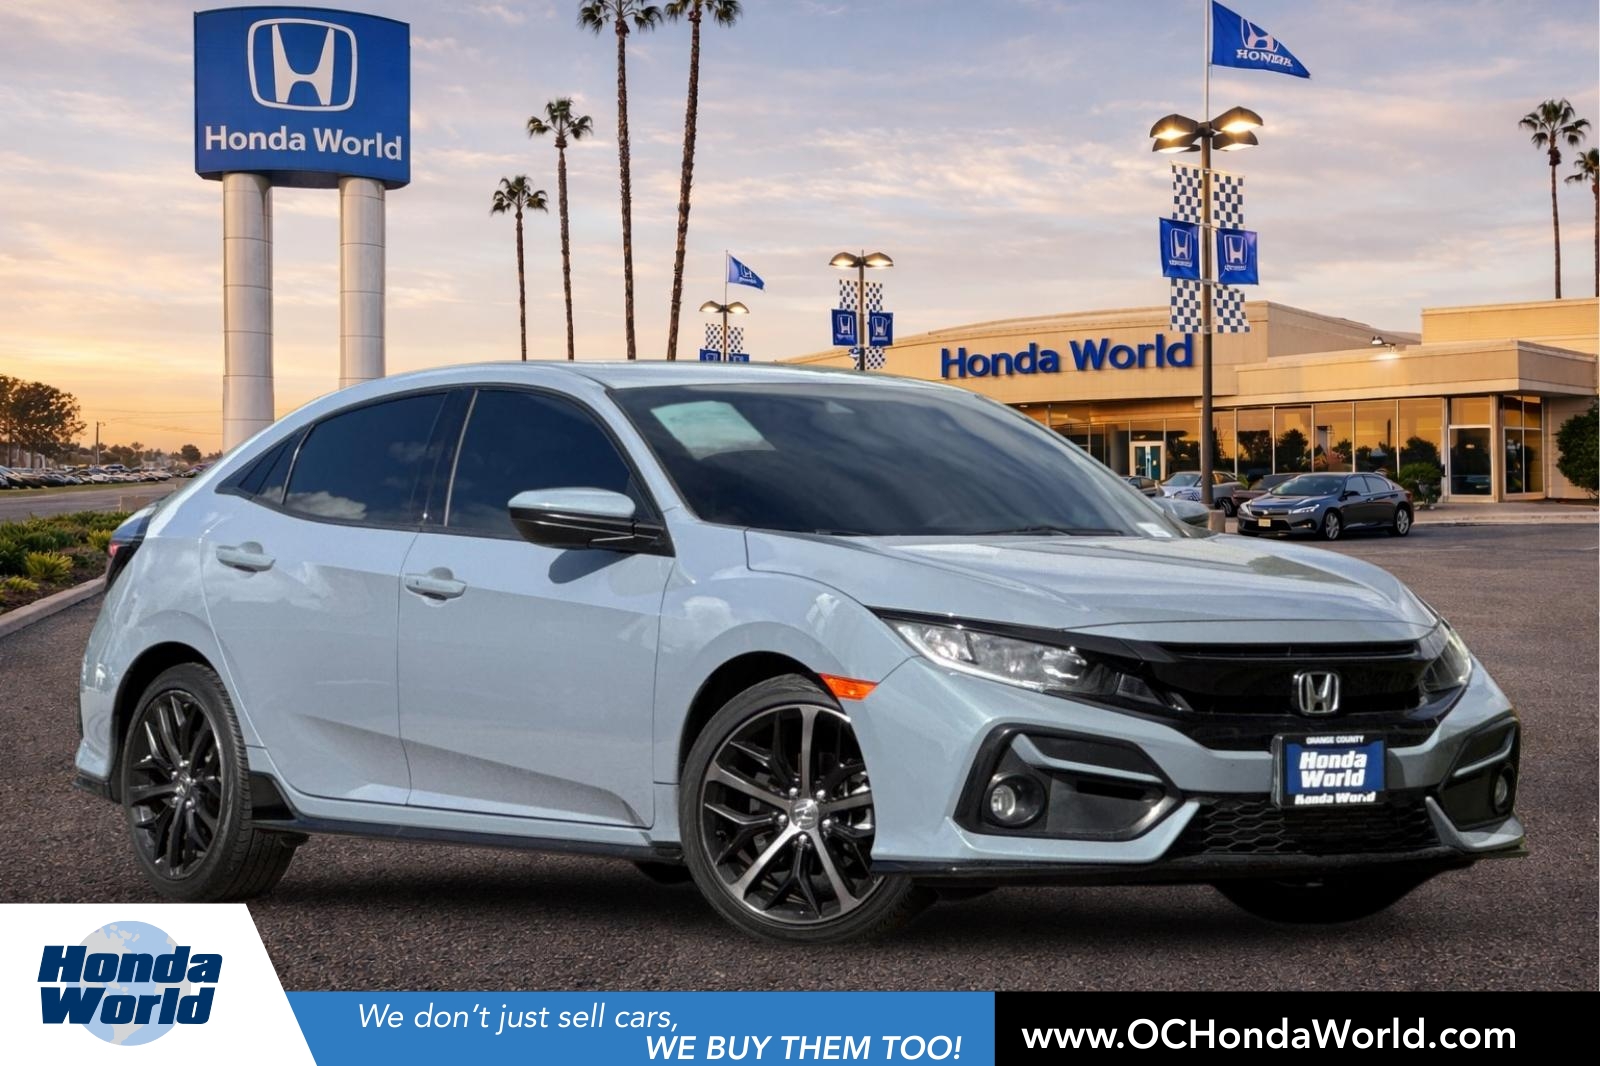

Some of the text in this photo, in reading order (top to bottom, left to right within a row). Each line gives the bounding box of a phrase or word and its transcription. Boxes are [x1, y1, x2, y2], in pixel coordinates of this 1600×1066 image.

[205, 125, 402, 161] Honda World
[941, 333, 1195, 378] Honda World
[1336, 735, 1365, 744] COUNTY
[1299, 750, 1368, 770] Honda
[1301, 769, 1366, 789] World
